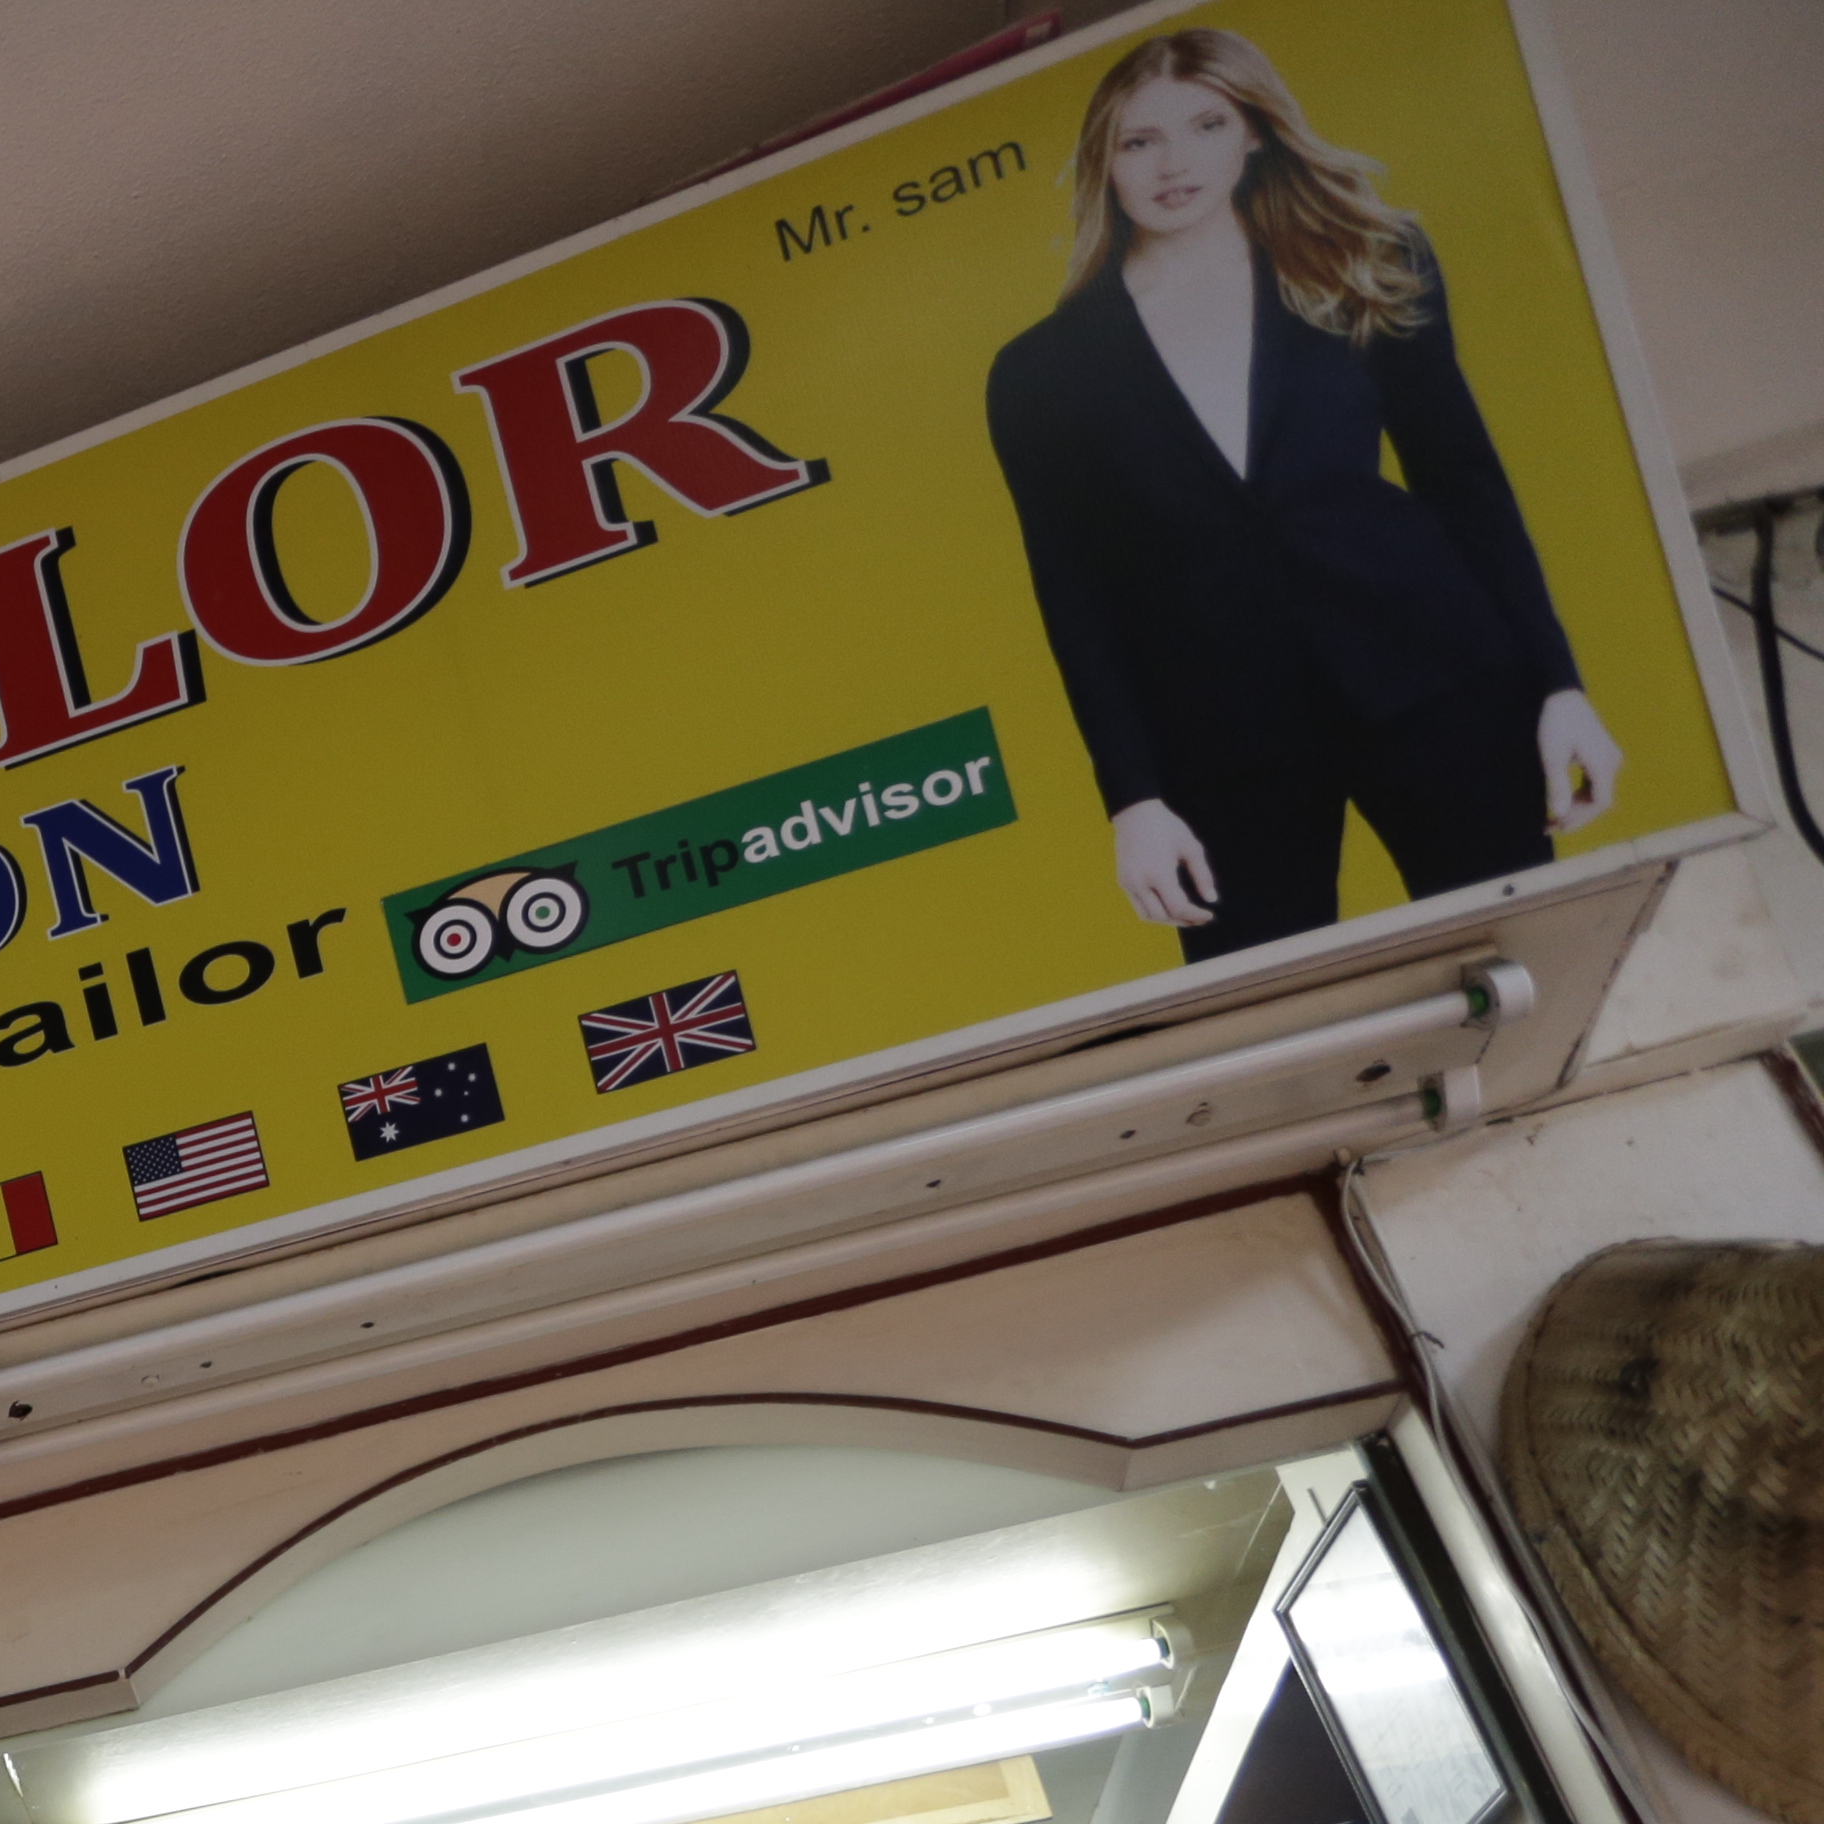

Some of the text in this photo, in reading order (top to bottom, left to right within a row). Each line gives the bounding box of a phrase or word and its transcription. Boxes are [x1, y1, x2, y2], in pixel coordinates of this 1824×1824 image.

[774, 140, 1028, 263] Mr. sam
[611, 754, 993, 901] Tripadvisor
